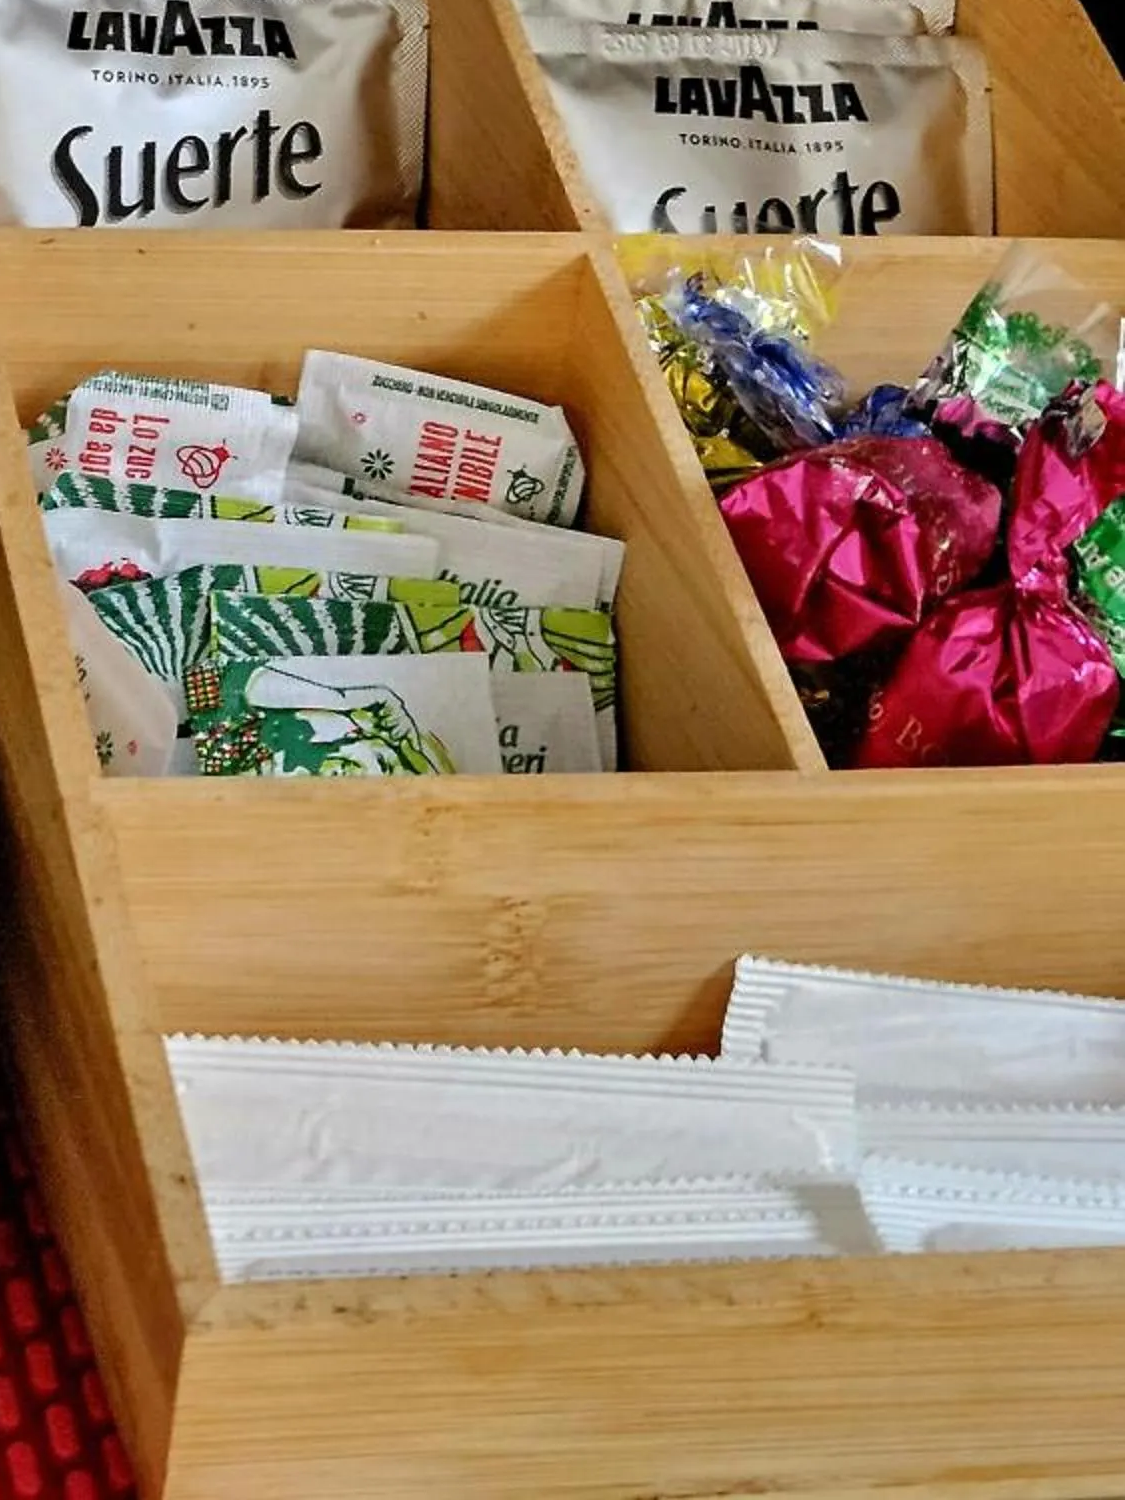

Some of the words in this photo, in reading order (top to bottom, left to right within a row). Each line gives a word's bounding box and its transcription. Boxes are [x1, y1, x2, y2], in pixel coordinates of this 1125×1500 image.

[66, 0, 298, 61] LAVAZZA
[653, 65, 870, 125] LAVAZZA
[49, 108, 324, 229] Suerte
[88, 407, 127, 434] da
[409, 421, 459, 499] ALIANO
[451, 429, 503, 504] NIBILE
